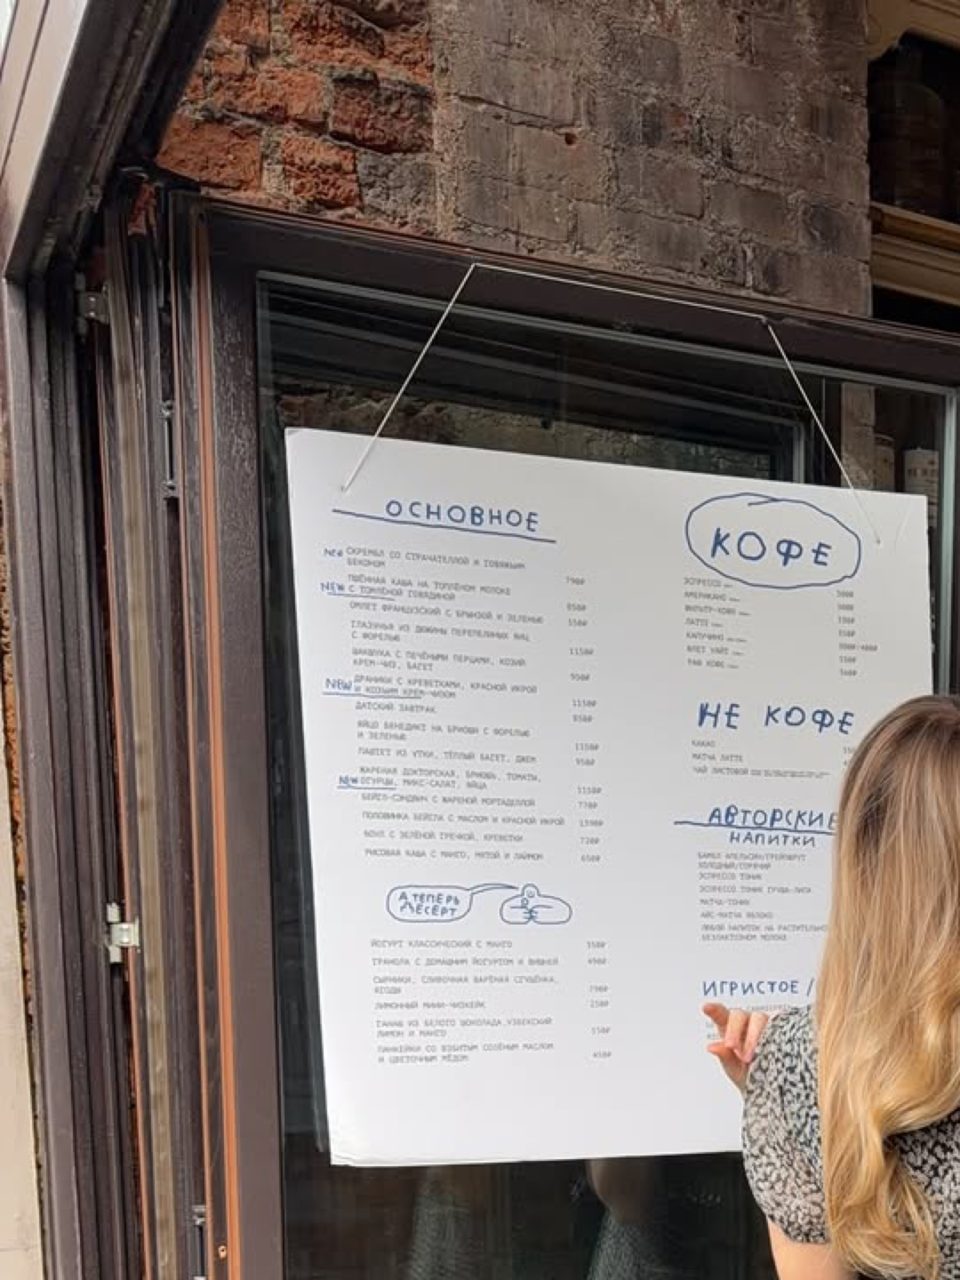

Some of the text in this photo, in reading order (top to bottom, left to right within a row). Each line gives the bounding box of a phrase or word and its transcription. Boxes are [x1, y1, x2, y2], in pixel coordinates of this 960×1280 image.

[386, 500, 538, 531] ОСНОВНОЕ
[711, 527, 832, 567] КОФЕ
[321, 582, 345, 593] NEW
[325, 678, 353, 691] NEW
[698, 702, 854, 735] НЕ КОФЕ
[708, 804, 839, 829] АВТОРСКИЕ
[729, 831, 816, 847] НАПИТКИ
[412, 892, 460, 905] ТЕПЕРЬ
[400, 901, 457, 917] ДЕСЕРТ
[702, 980, 799, 997] ИГРИСТОЕ
